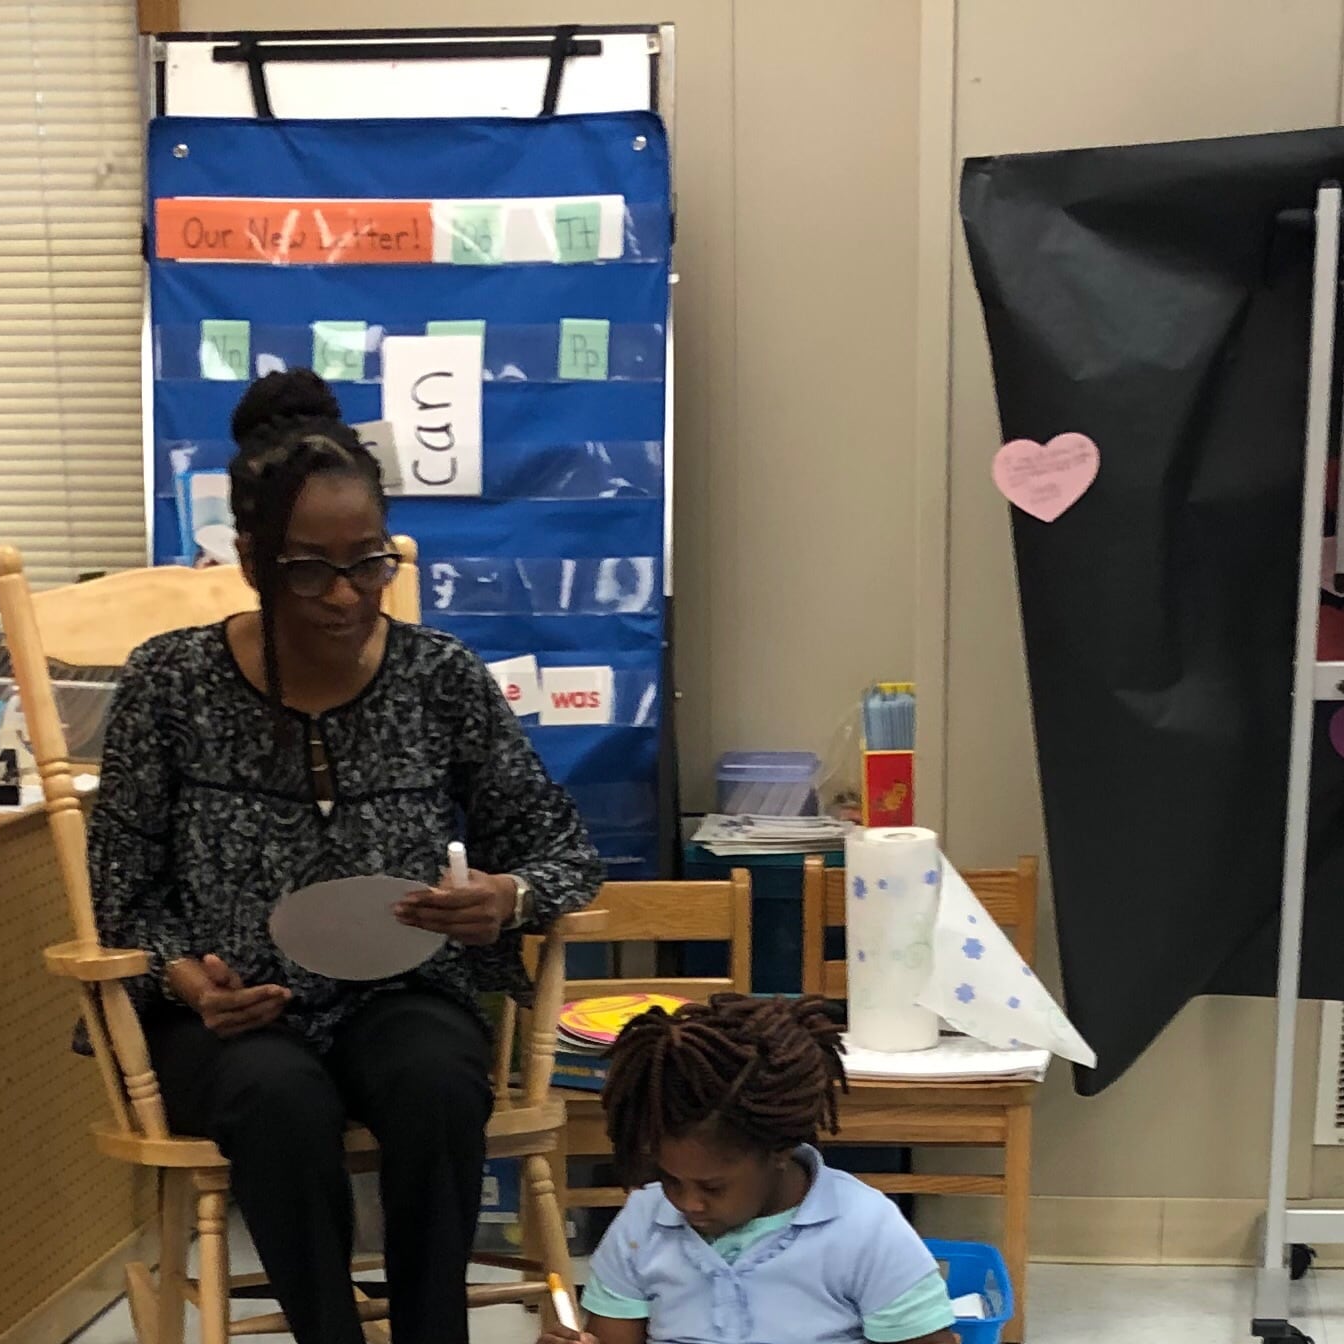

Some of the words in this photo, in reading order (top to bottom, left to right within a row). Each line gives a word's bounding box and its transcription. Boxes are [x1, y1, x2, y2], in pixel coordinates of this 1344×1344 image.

[183, 216, 233, 249] Our
[248, 217, 306, 250] New
[556, 215, 595, 251] Tt
[571, 333, 600, 375] Pp
[410, 371, 458, 487] can
[549, 690, 602, 709] was
